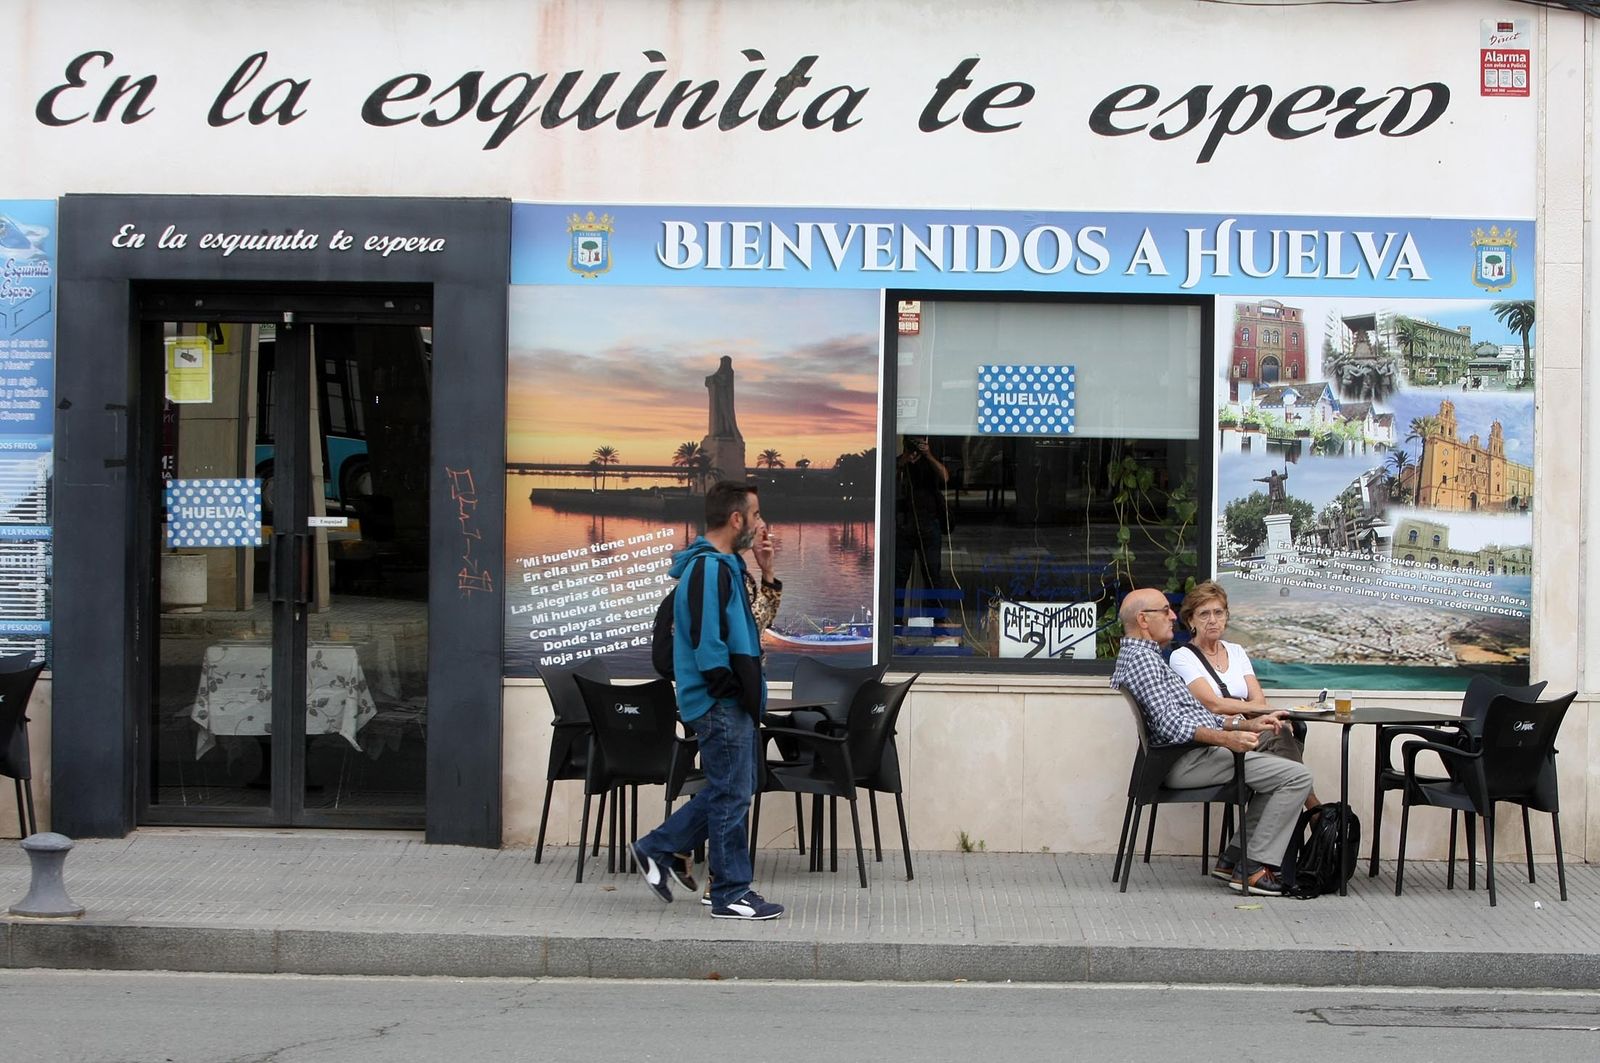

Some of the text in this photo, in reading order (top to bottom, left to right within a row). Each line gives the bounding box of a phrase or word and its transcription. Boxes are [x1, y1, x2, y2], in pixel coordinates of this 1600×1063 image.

[1485, 51, 1526, 62] Alarma
[36, 51, 157, 126] En
[208, 52, 310, 127] la
[919, 58, 1035, 132] te
[1089, 83, 1450, 163] espero
[112, 224, 145, 249] En
[158, 225, 187, 249] la
[329, 230, 353, 250] te
[364, 235, 446, 256] espero
[656, 218, 1432, 288] BIENVENIDOS A HUELVA
[993, 393, 1060, 406] HUELVA
[182, 507, 247, 518] HUELVA
[523, 544, 673, 582] En ella un barco velero
[542, 548, 587, 563] huelva
[591, 538, 624, 553] tiene
[628, 533, 653, 544] una
[1278, 541, 1290, 549] En
[1292, 543, 1331, 554] nuestro
[1373, 554, 1421, 568] Choquero
[1424, 562, 1436, 570] no
[1439, 563, 1449, 571] te
[531, 585, 548, 595] En
[552, 581, 563, 591] el
[566, 574, 603, 588] barco
[607, 568, 623, 578] mi
[1260, 563, 1284, 572] vieja
[1376, 578, 1419, 592] Romana,
[1500, 596, 1527, 607] Mora,
[1334, 561, 1366, 571] hemos
[1369, 566, 1416, 578] heredado
[1418, 571, 1427, 580] la
[1430, 573, 1492, 589] hospitalidad
[511, 603, 533, 614] Las
[592, 586, 604, 596] de
[611, 584, 623, 593] la
[627, 577, 651, 590] que
[532, 613, 548, 624] Mi
[552, 604, 596, 620] huelva
[599, 596, 633, 610] tiene
[637, 590, 662, 601] una
[1234, 571, 1269, 582] Huelva
[1272, 575, 1281, 583] la
[1284, 577, 1327, 590] llevamos
[1345, 586, 1353, 594] el
[1356, 588, 1379, 597] alma
[1381, 592, 1387, 600] y
[1390, 592, 1400, 600] te
[1402, 594, 1434, 605] vamos
[1445, 600, 1472, 609] ceder
[1490, 606, 1525, 617] trocito.
[530, 628, 556, 639] Con
[560, 617, 602, 636] playas
[605, 613, 621, 623] de
[1004, 607, 1030, 628] CAFE
[1044, 607, 1093, 628] CHURROS
[541, 653, 573, 666] Moja
[576, 649, 591, 659] su
[594, 641, 628, 655] mata
[631, 637, 647, 646] de
[544, 635, 587, 651] Donde
[590, 632, 602, 640] la
